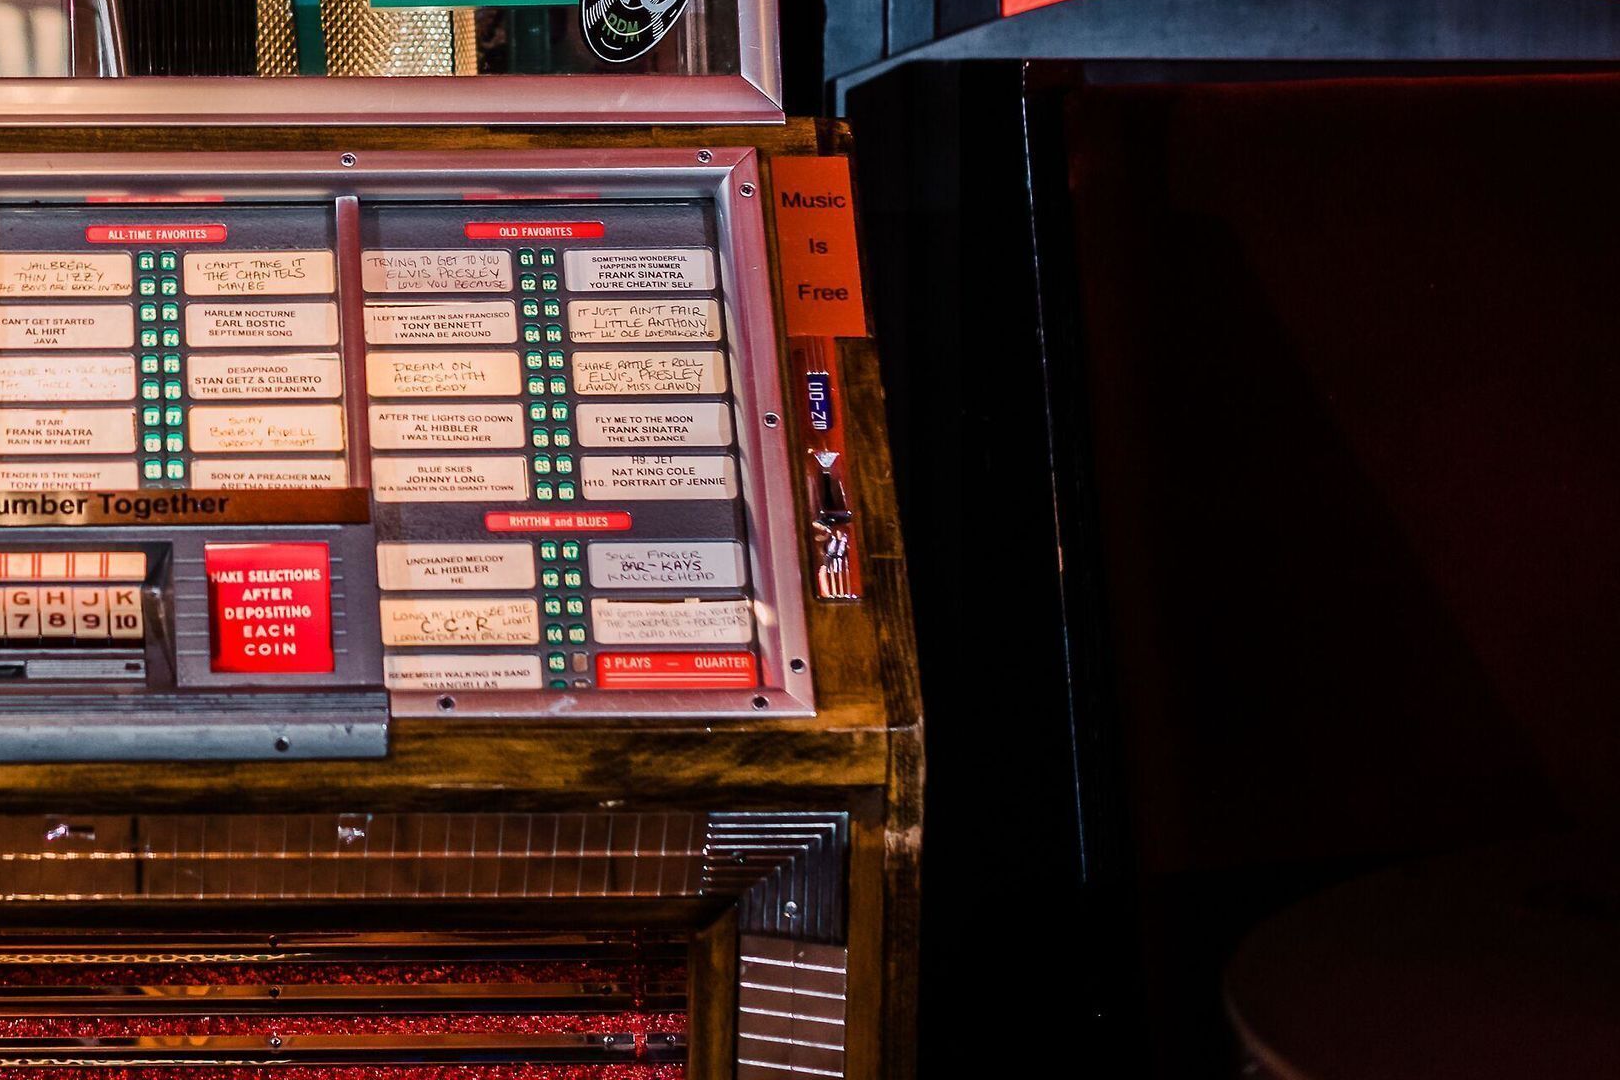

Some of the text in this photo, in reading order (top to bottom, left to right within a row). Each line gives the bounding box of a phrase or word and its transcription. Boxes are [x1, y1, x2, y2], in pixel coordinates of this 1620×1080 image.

[782, 192, 846, 208] Music
[108, 229, 207, 239] ALL-TIME FAVORITES
[499, 228, 572, 236] OLD FAVORITES
[809, 239, 828, 254] Is
[521, 254, 554, 265] G1 H1
[638, 271, 684, 279] SINATRA
[521, 279, 557, 290] G2 H2
[798, 284, 848, 300] Free
[216, 320, 286, 328] EARL BOSTIC
[434, 321, 482, 329] BENNETT
[228, 376, 254, 384] GETZ
[258, 376, 265, 384] &
[268, 376, 321, 384] GILBERTO
[808, 382, 826, 430] COINS
[431, 425, 478, 433] HIBBLER
[406, 475, 484, 484] JOHNNY LONG
[613, 478, 726, 486] PORTRAIT OF JENNIE
[102, 494, 230, 517] Together
[510, 517, 608, 527] RHYTHM and BLUES
[211, 569, 321, 582] MAKE SELECTIONS
[13, 591, 30, 605] G
[47, 591, 64, 605] H
[82, 591, 98, 606] J
[116, 591, 133, 604] K
[242, 588, 292, 600] AFTER
[225, 606, 312, 618] DEPOSITING
[14, 614, 29, 628] 7
[49, 614, 65, 628] 8
[84, 614, 100, 628] 9
[115, 615, 137, 629] 10
[244, 624, 295, 637] EACH
[244, 643, 296, 655] COIN
[603, 657, 749, 668] 3 PLAYS QUARTER
